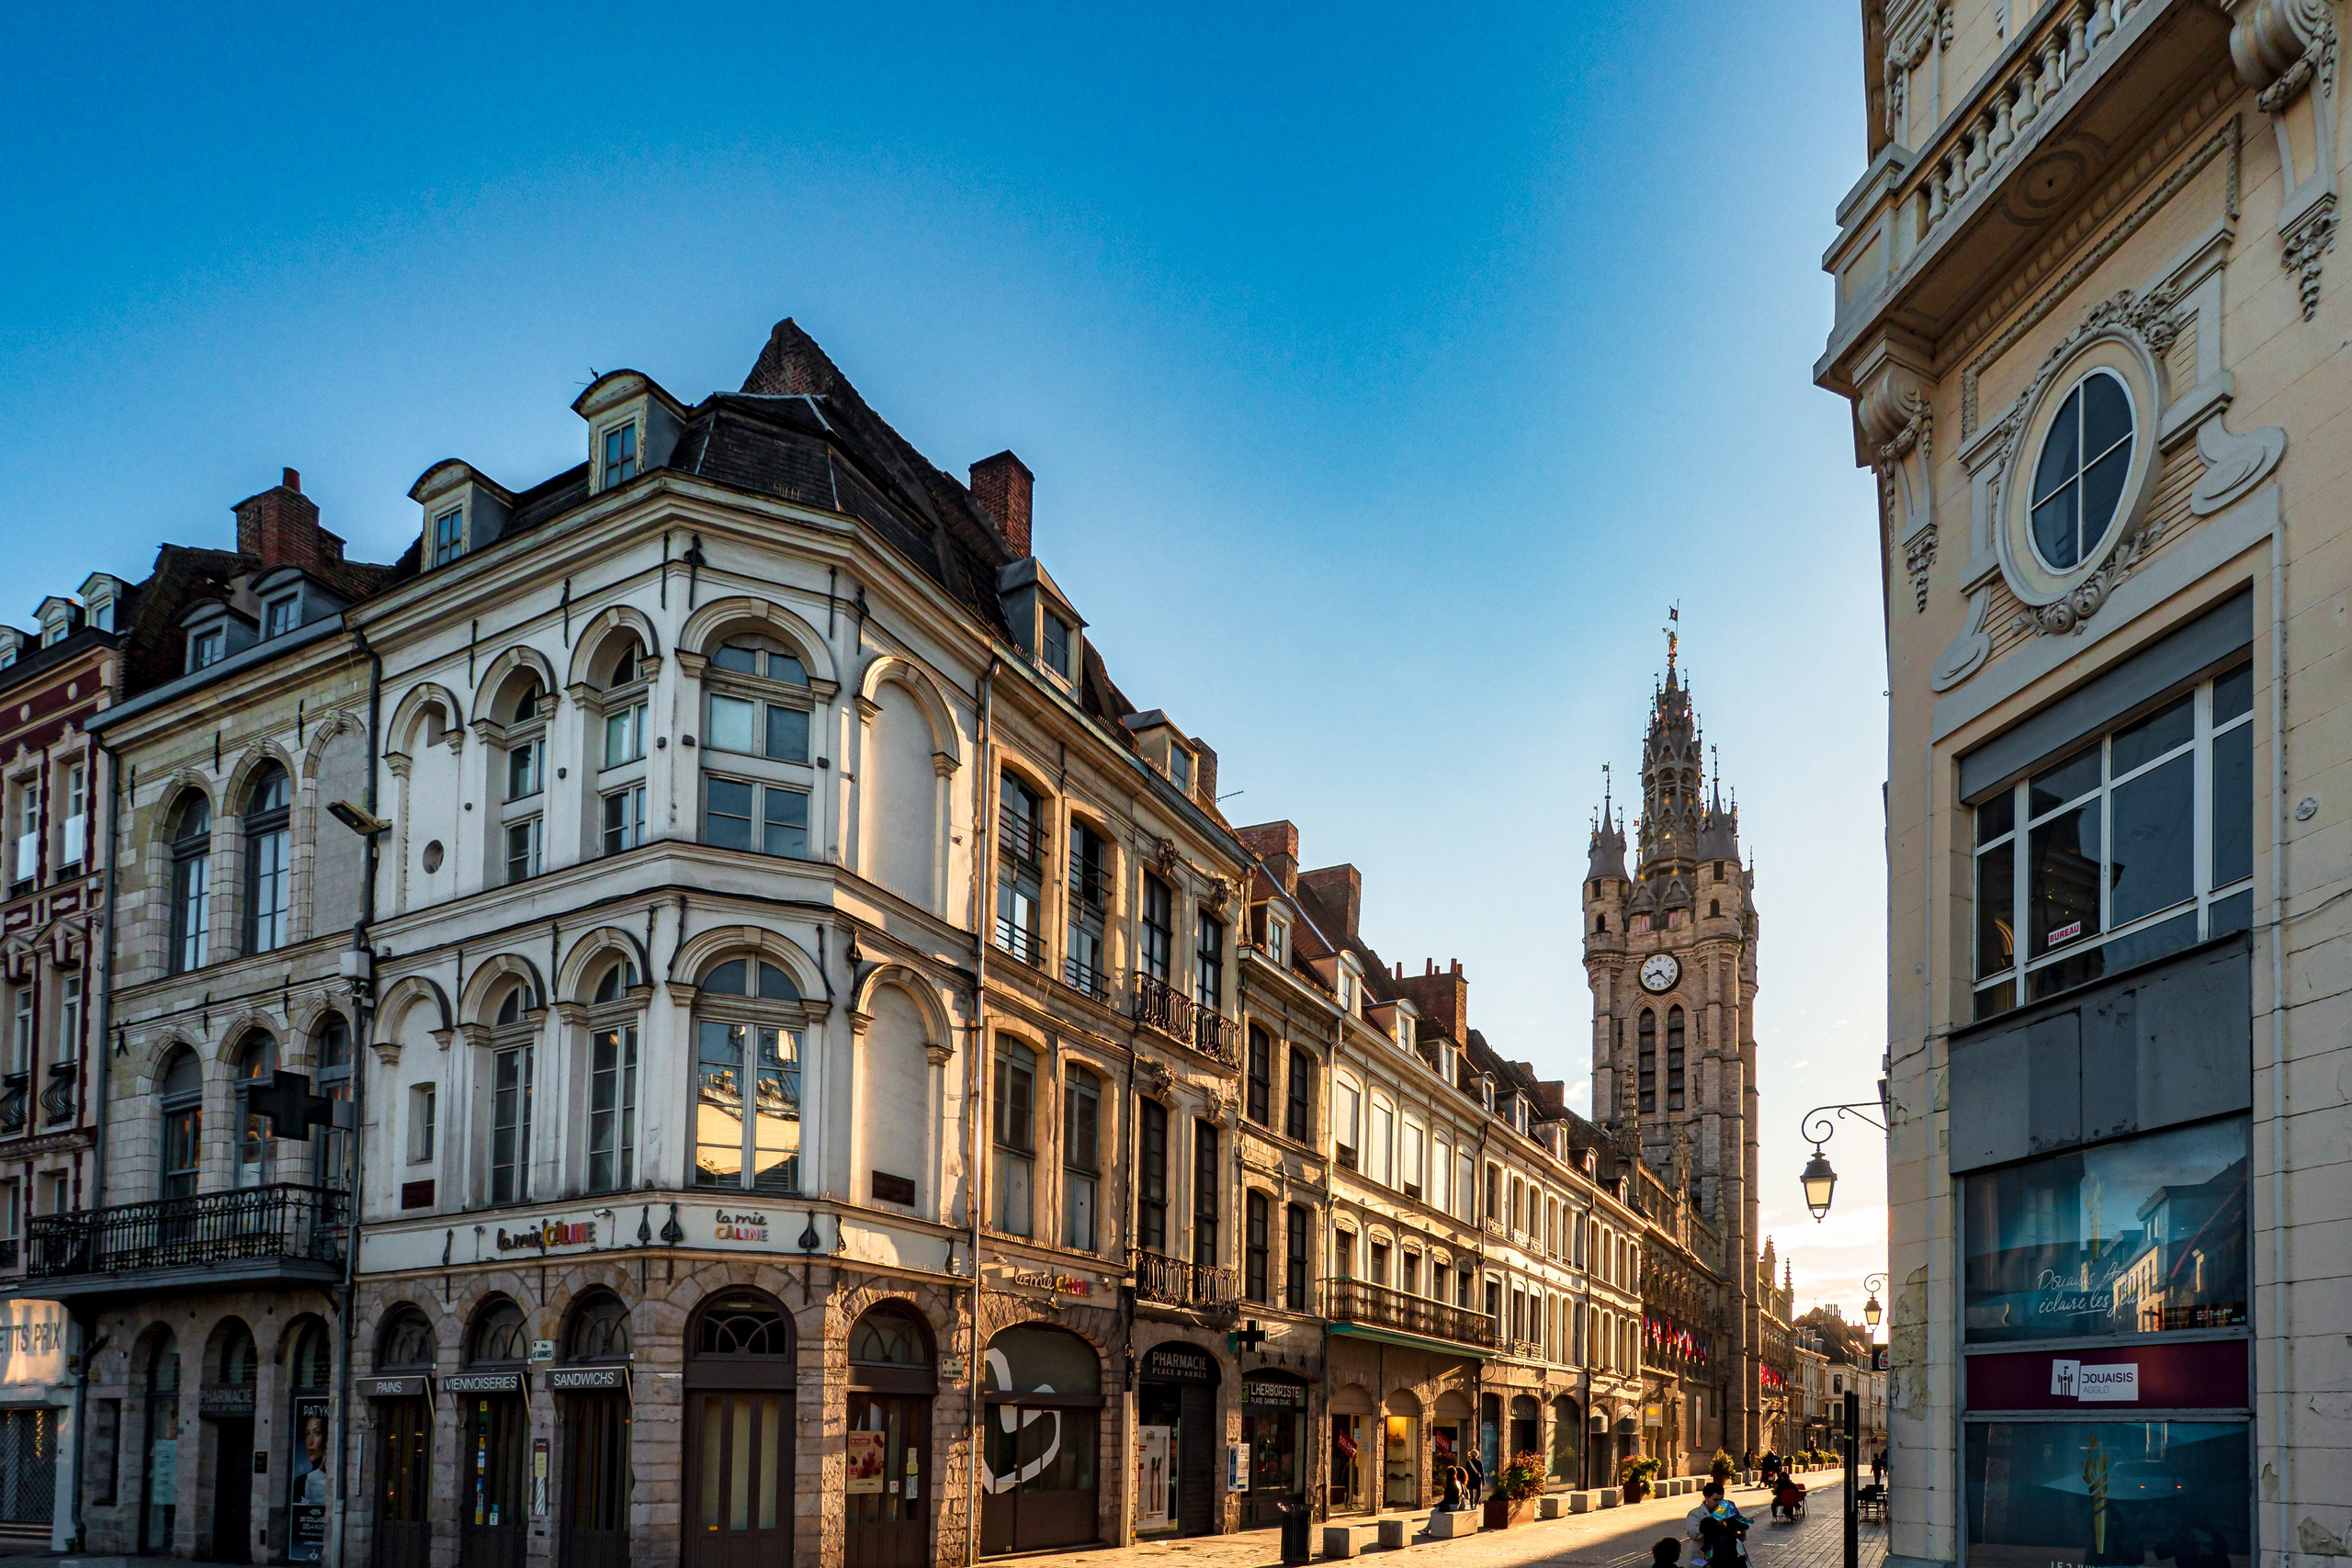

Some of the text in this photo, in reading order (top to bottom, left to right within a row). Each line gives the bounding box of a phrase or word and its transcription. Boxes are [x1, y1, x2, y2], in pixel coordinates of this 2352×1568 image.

[2050, 924, 2079, 942] BUREAU
[717, 1208, 768, 1225] la mie
[714, 1224, 769, 1242] CÂLINE
[2039, 1291, 2086, 1314] éclaire
[2090, 1286, 2110, 1308] les
[34, 1322, 62, 1351] PRIX
[1152, 1351, 1207, 1371] PHARMACIE
[554, 1371, 615, 1386] SANDWICHS
[1152, 1367, 1174, 1376] PLACE
[2082, 1372, 2133, 1383] DOUAISIS
[376, 1382, 402, 1393] PAINS
[445, 1376, 517, 1390] VIENNOISERIES
[2083, 1385, 2109, 1394] AGGLO
[199, 1389, 254, 1403] PHARMACIE
